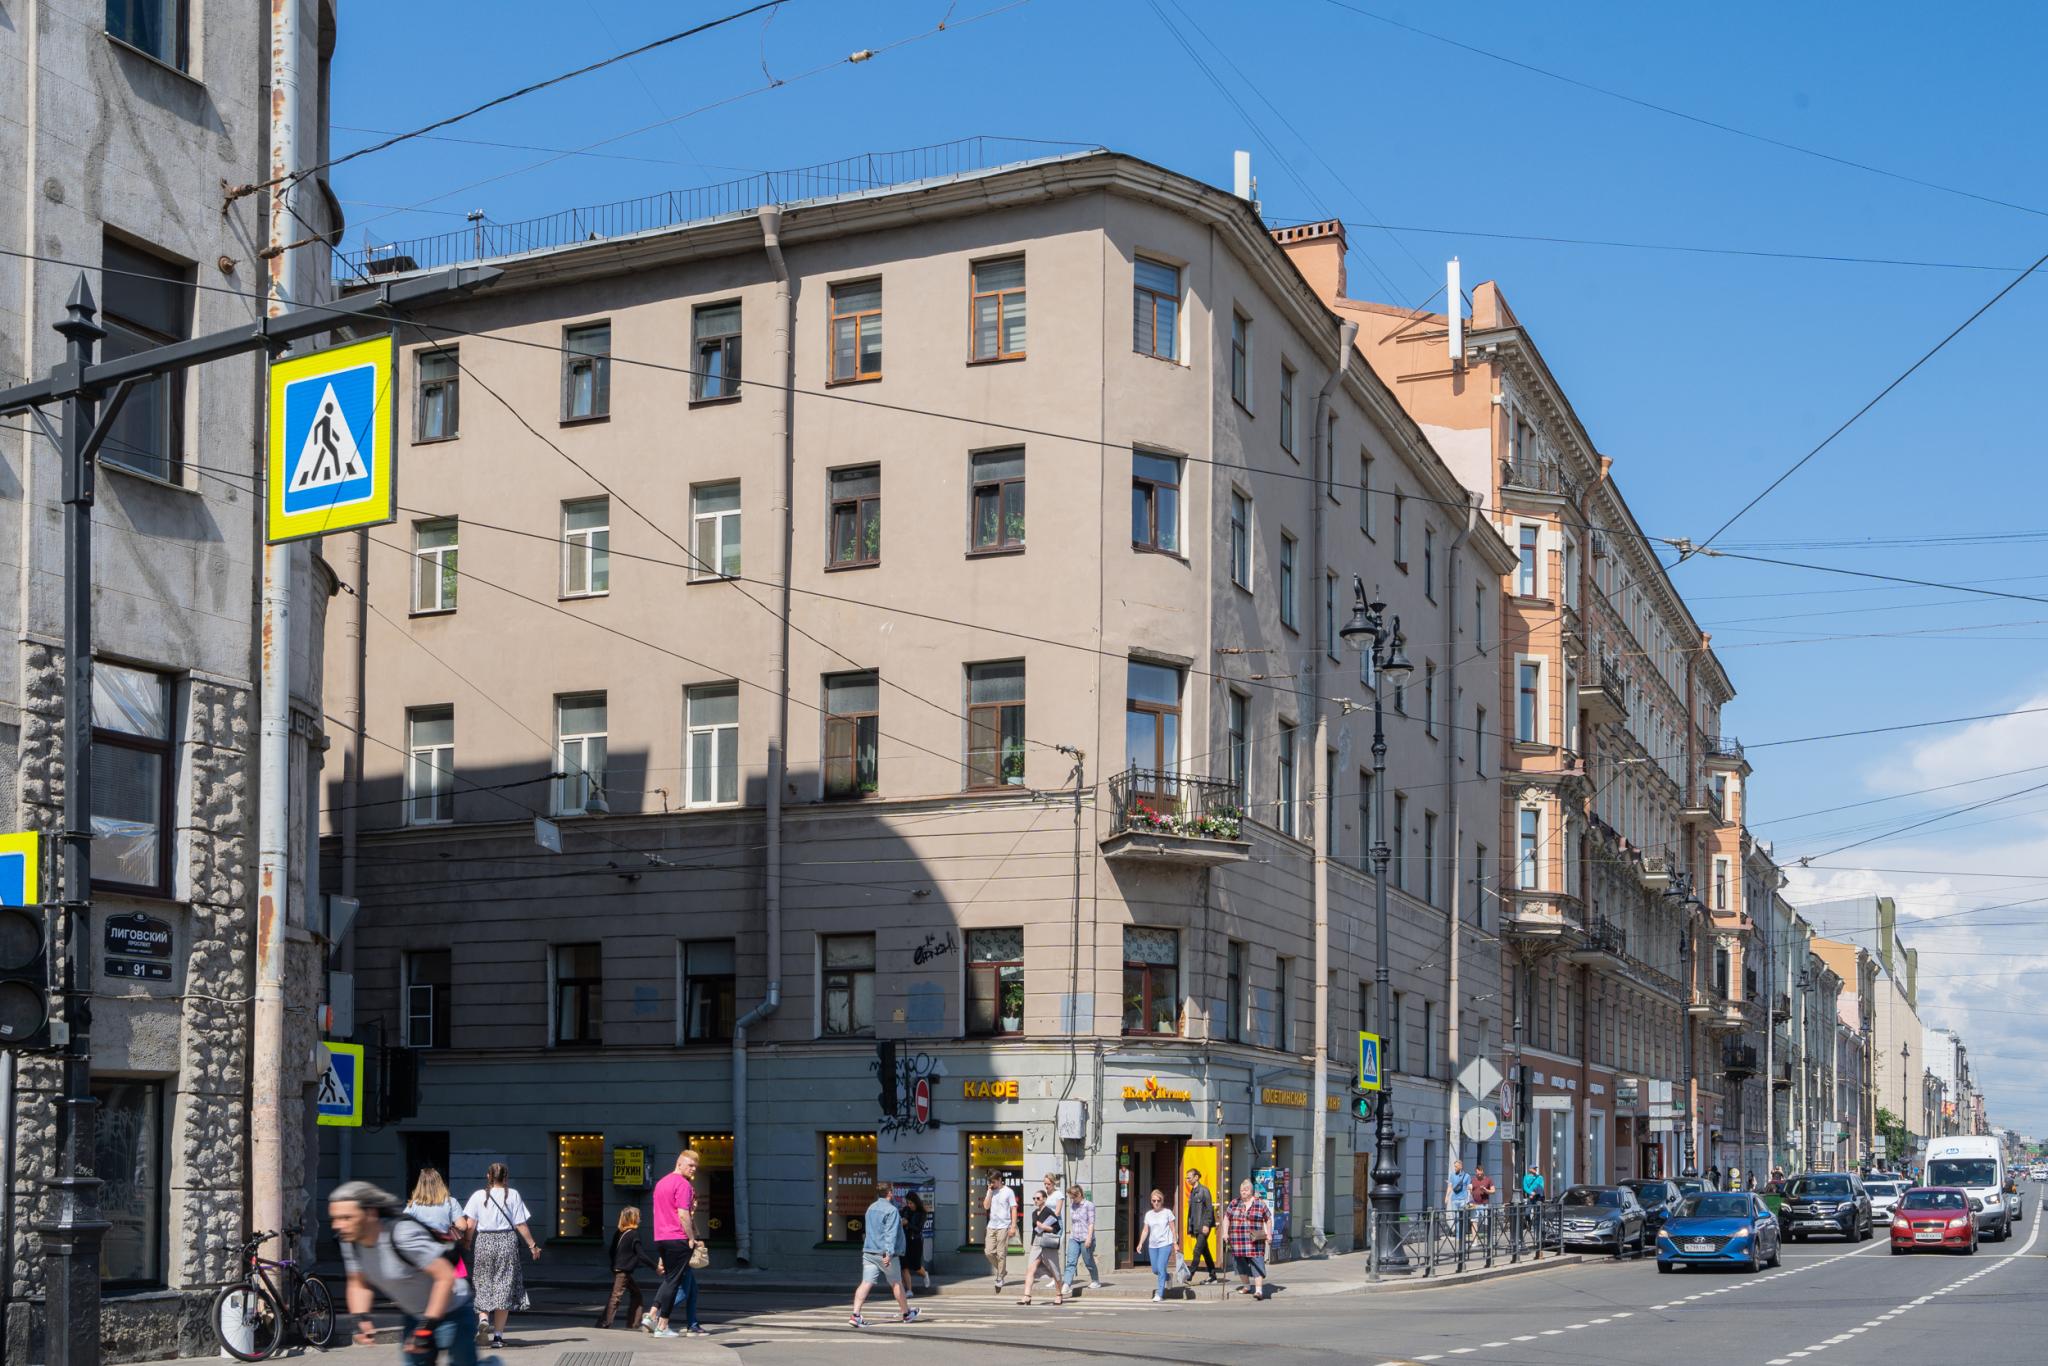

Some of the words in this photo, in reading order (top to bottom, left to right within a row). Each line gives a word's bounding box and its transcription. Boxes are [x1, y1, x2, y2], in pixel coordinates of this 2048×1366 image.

[111, 927, 168, 943] ЛИГОВСКИЙ
[133, 963, 146, 976] 91
[964, 1080, 1019, 1098] КАФЕ
[1262, 1088, 1307, 1106] ОСЕТИНСКАЯ
